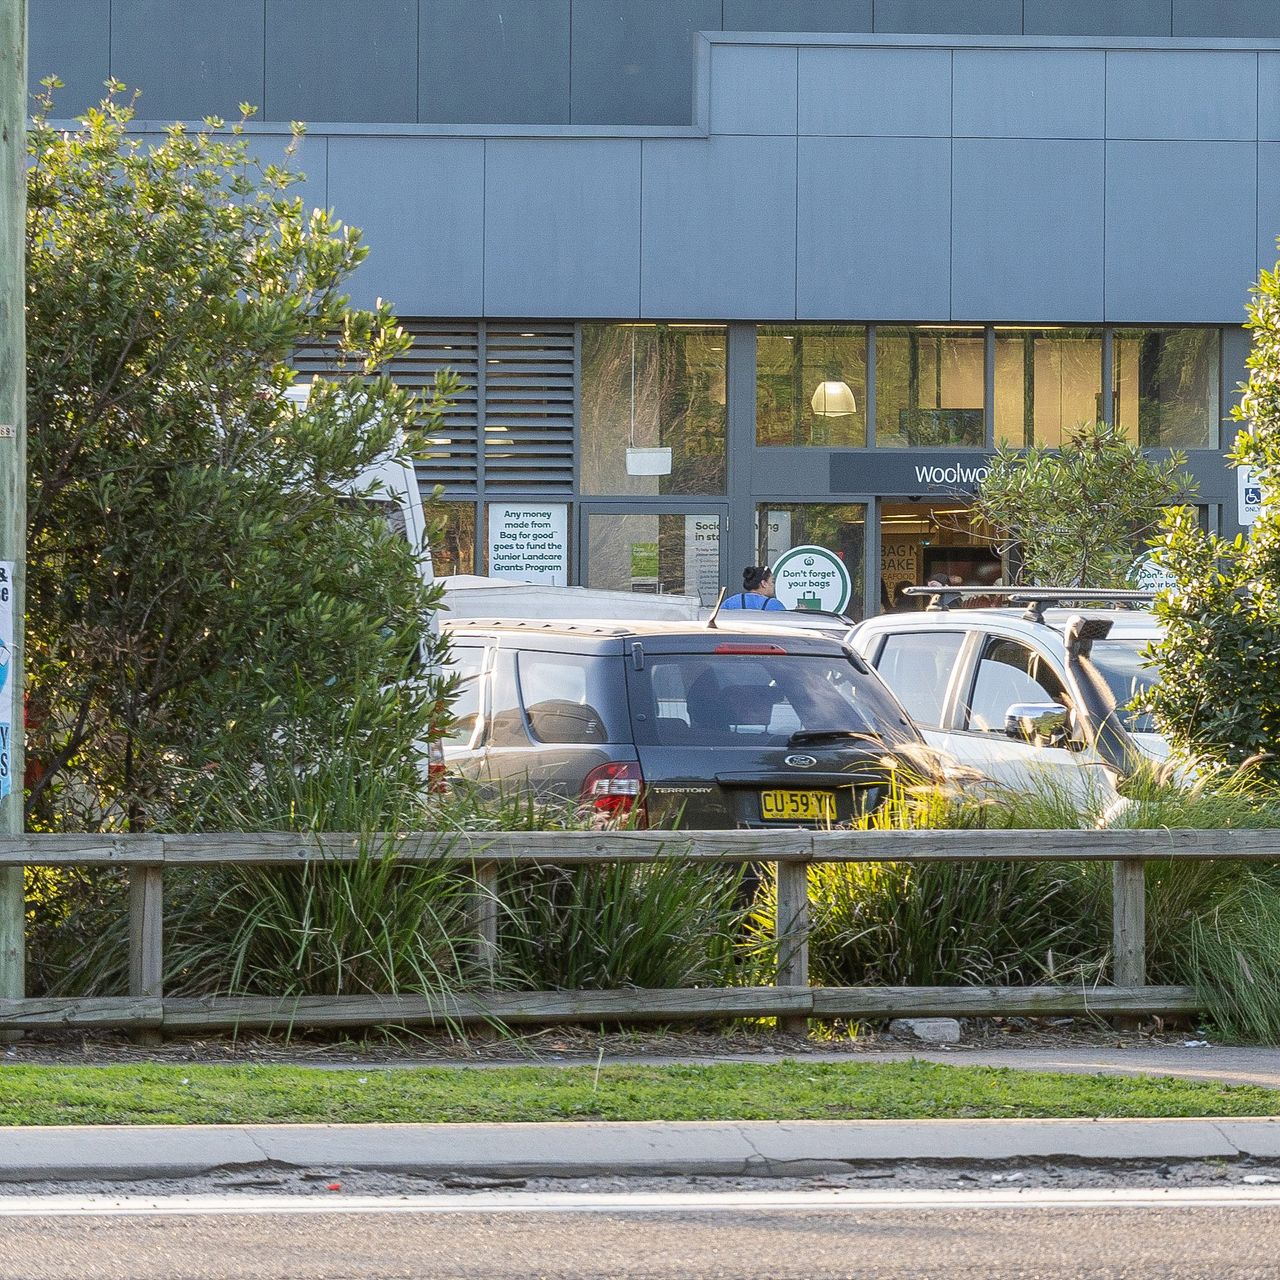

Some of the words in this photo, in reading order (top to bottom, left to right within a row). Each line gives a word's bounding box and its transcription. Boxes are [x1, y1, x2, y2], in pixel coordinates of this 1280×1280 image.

[504, 511, 521, 519] Any
[500, 532, 517, 540] Bag
[493, 544, 514, 552] goes
[525, 564, 562, 572] Program
[783, 570, 807, 578] Don't
[809, 570, 836, 579] forget
[809, 580, 830, 589] bags
